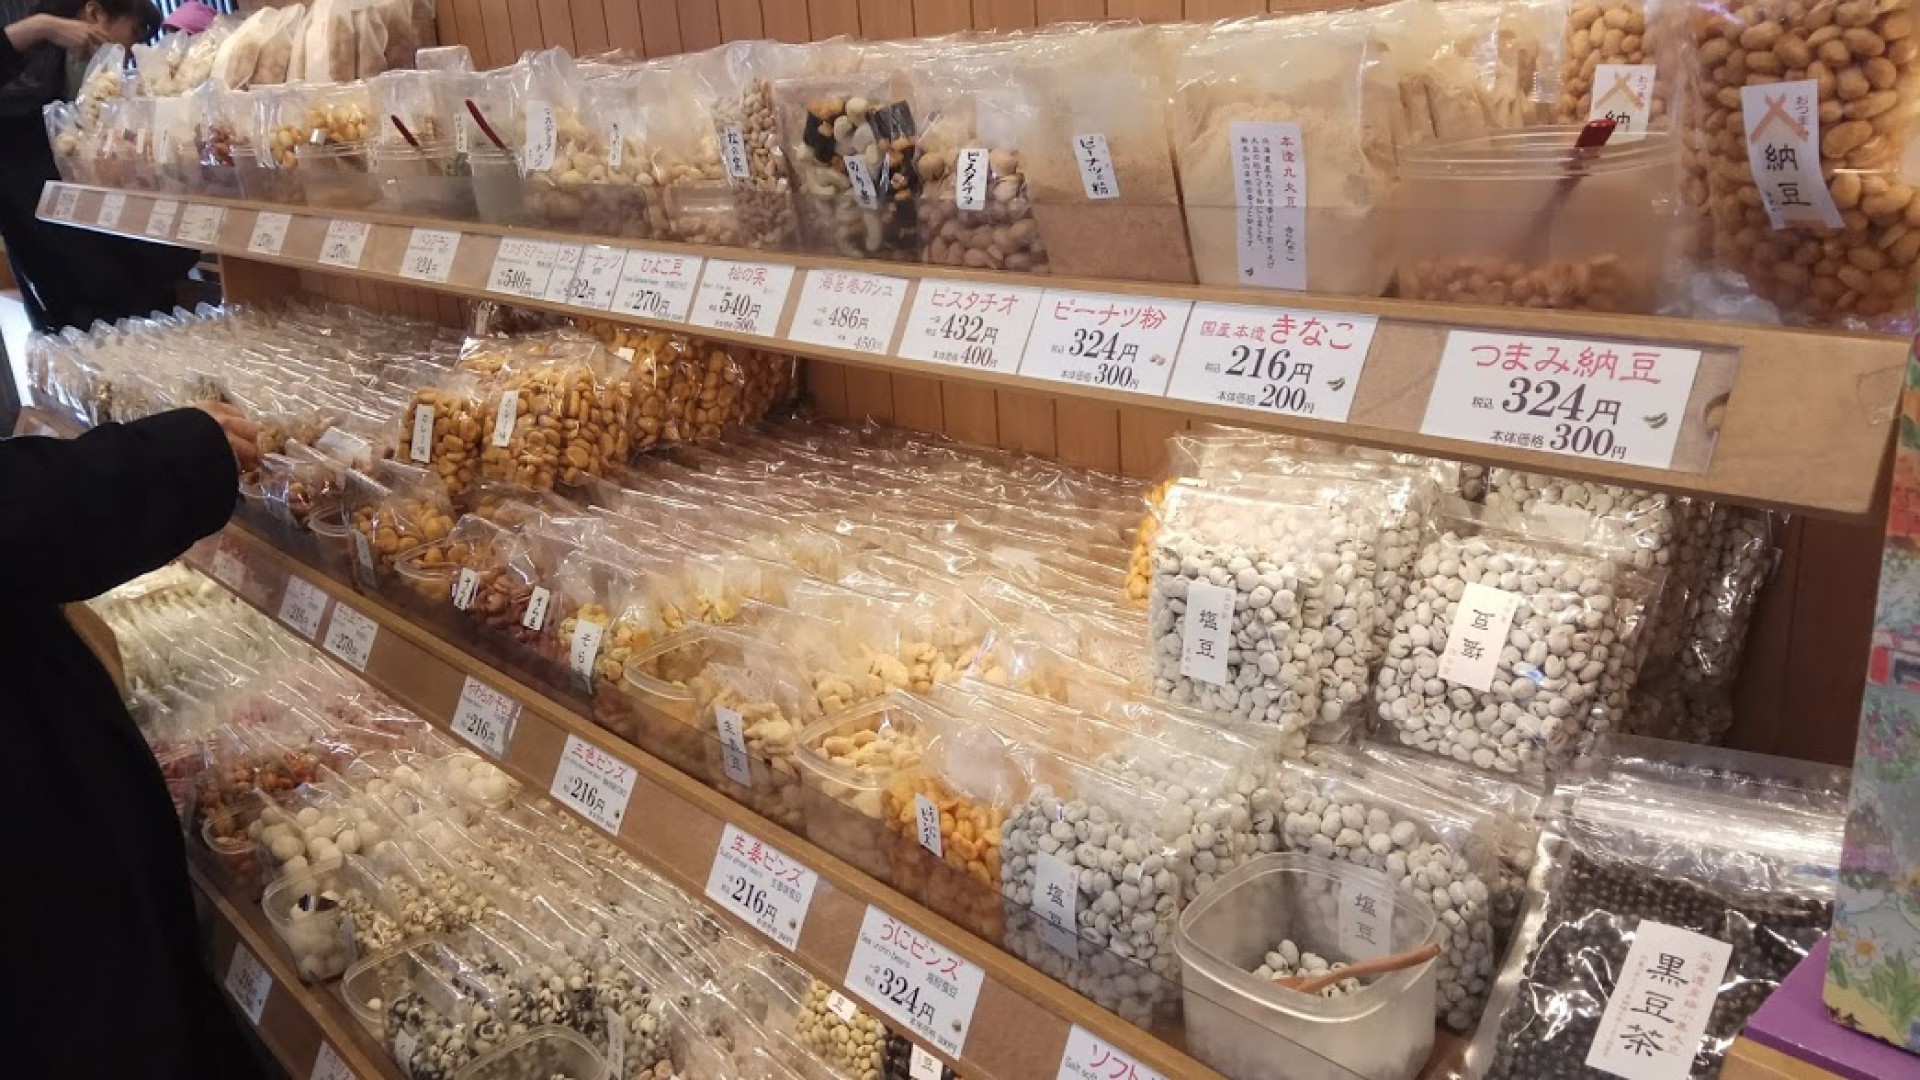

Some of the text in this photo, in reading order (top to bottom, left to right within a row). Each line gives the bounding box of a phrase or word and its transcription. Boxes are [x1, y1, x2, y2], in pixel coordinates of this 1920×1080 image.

[1765, 143, 1811, 207] 納豆
[641, 257, 684, 276] ひよこ豆
[727, 265, 768, 286] 松の実
[632, 290, 671, 313] 270円
[720, 291, 761, 319] 540円
[828, 306, 869, 330] 486円
[931, 287, 1019, 315] ピスタチオ
[1054, 299, 1167, 330] ピーナツ粉
[941, 314, 999, 345] 432円
[1069, 328, 1139, 363] 324円
[1271, 314, 1354, 350] きなこ
[960, 345, 998, 368] 400円
[1225, 345, 1313, 384] 216円
[1472, 343, 1661, 384] つまみ納豆
[1094, 363, 1139, 390] 300円
[1258, 384, 1314, 413] 200円
[1503, 377, 1621, 425] 324円
[1490, 424, 1627, 459] 本体価格 300円
[1196, 609, 1219, 660] 塩豆
[571, 776, 605, 814] 216円
[731, 877, 778, 923] 216円
[1354, 893, 1377, 945] 塩豆
[880, 918, 964, 981] うにビンズ
[878, 968, 935, 1025] 324円
[1620, 952, 1689, 1057] 黒豆茶
[1089, 1044, 1162, 1080] ソフト
